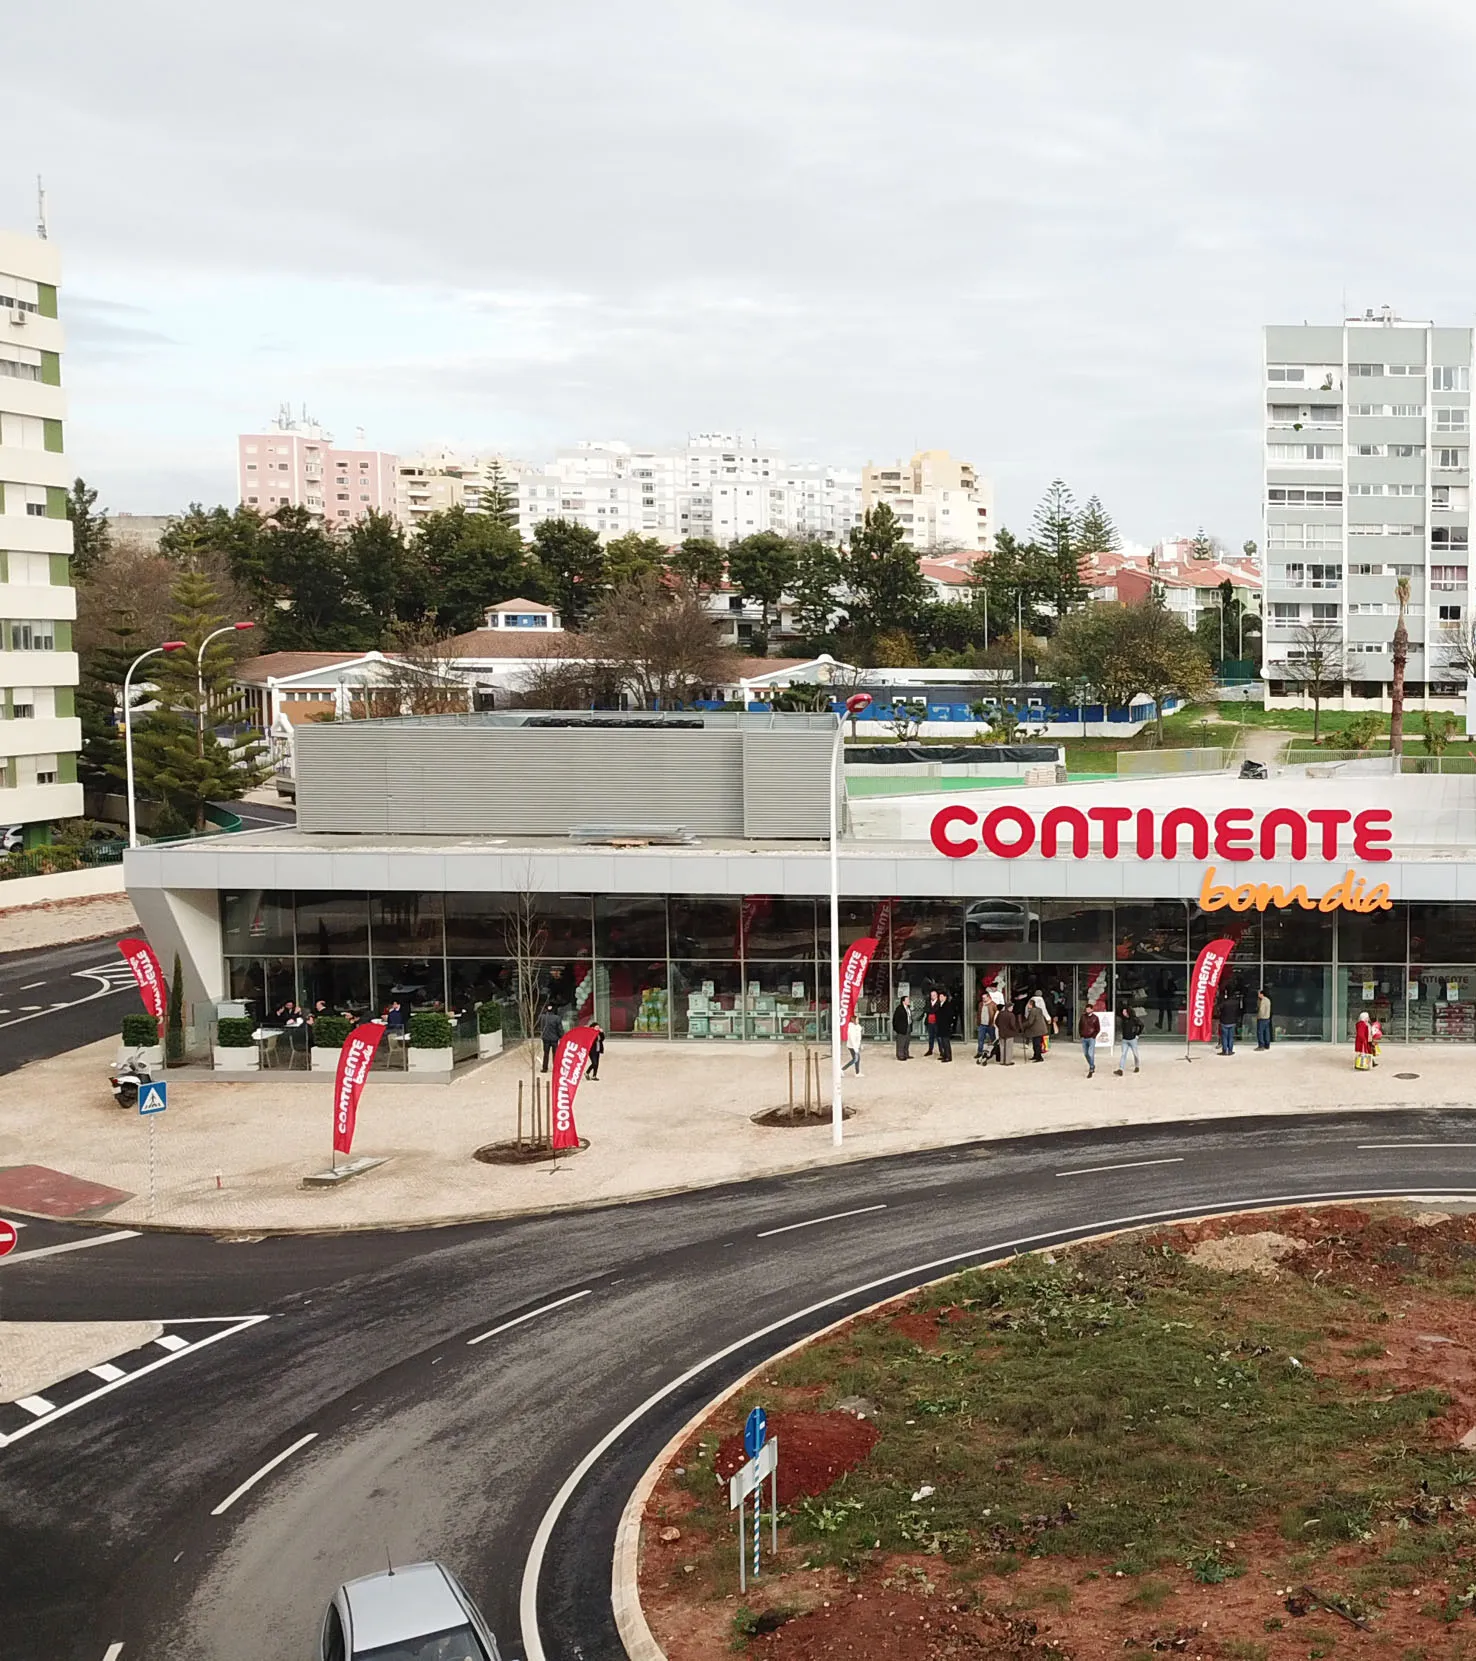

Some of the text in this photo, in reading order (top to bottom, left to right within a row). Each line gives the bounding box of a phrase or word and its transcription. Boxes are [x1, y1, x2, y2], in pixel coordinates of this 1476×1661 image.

[930, 804, 1393, 862] CONTINENTE
[1199, 866, 1393, 913] bom dia
[839, 950, 862, 1026] CONTINENTE
[1193, 951, 1217, 1027] CONTINENTE
[339, 1038, 365, 1134] CONTINENTE
[352, 1044, 374, 1085] bom dia
[557, 1040, 579, 1131] CONTINENTE
[567, 1047, 587, 1086] bom dia
